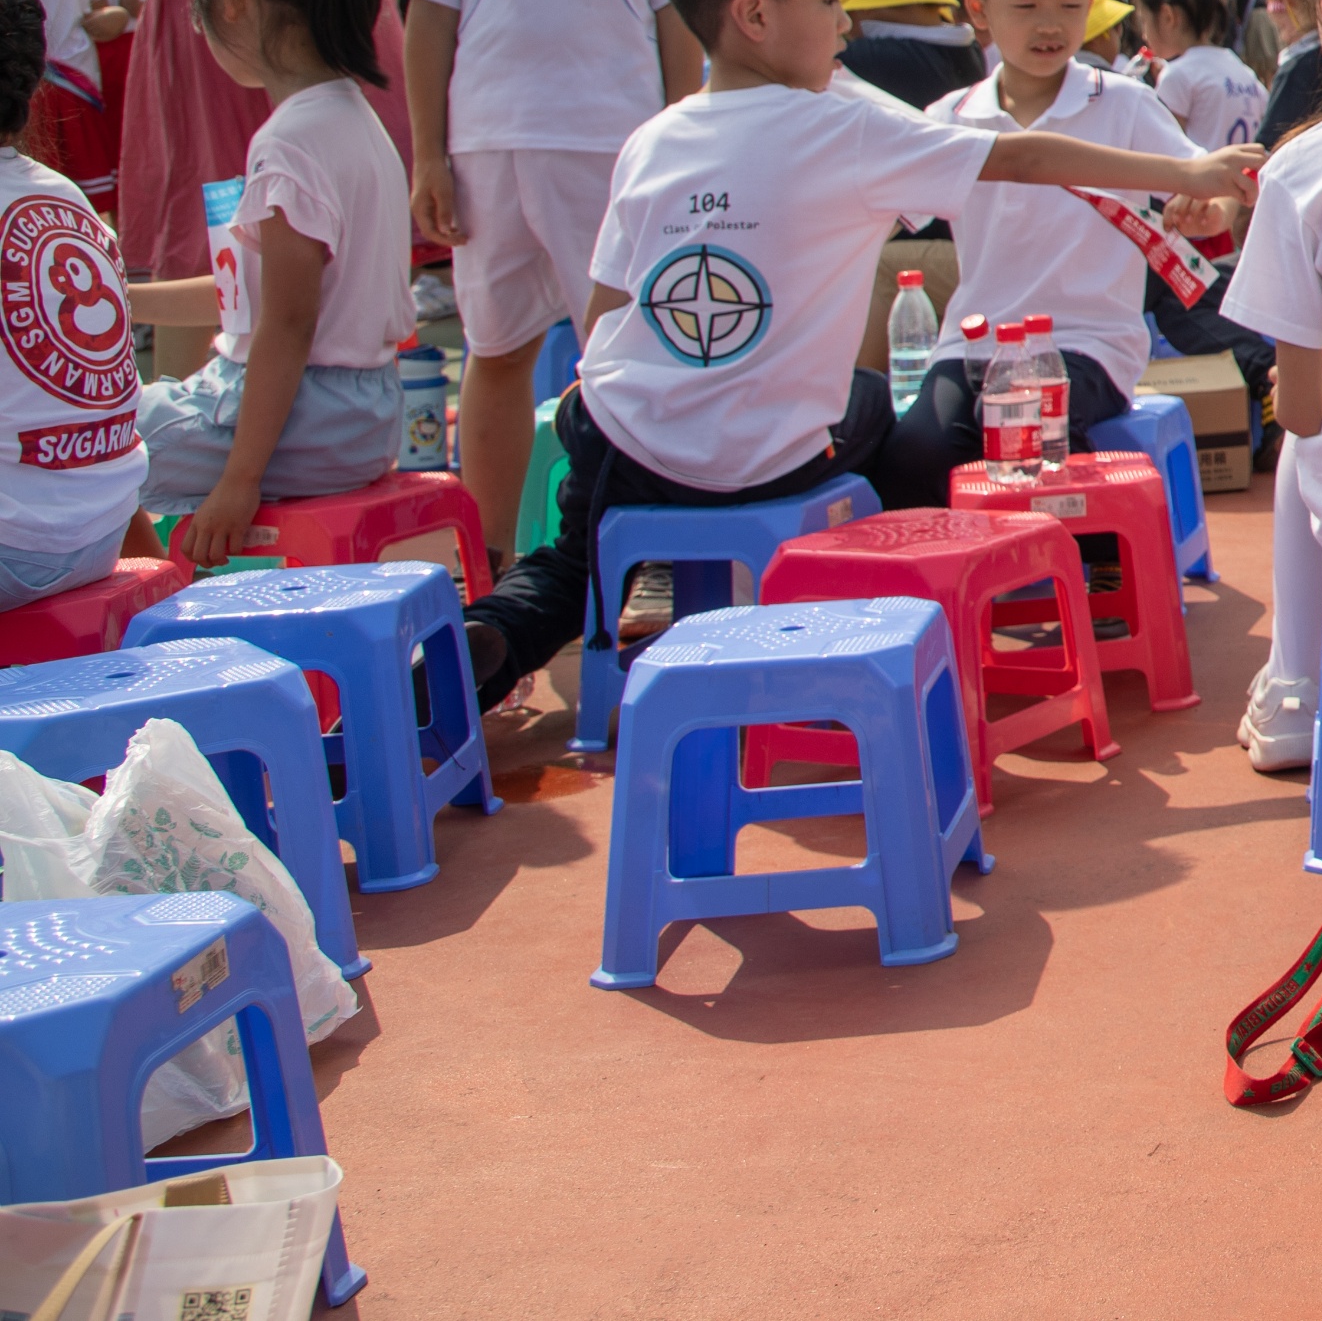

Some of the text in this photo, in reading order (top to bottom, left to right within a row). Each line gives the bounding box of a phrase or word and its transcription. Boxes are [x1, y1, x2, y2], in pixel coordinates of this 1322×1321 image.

[689, 192, 730, 214] 104
[6, 206, 110, 267] SUGARMAN
[706, 220, 760, 231] Polestar
[6, 281, 45, 349] SGM
